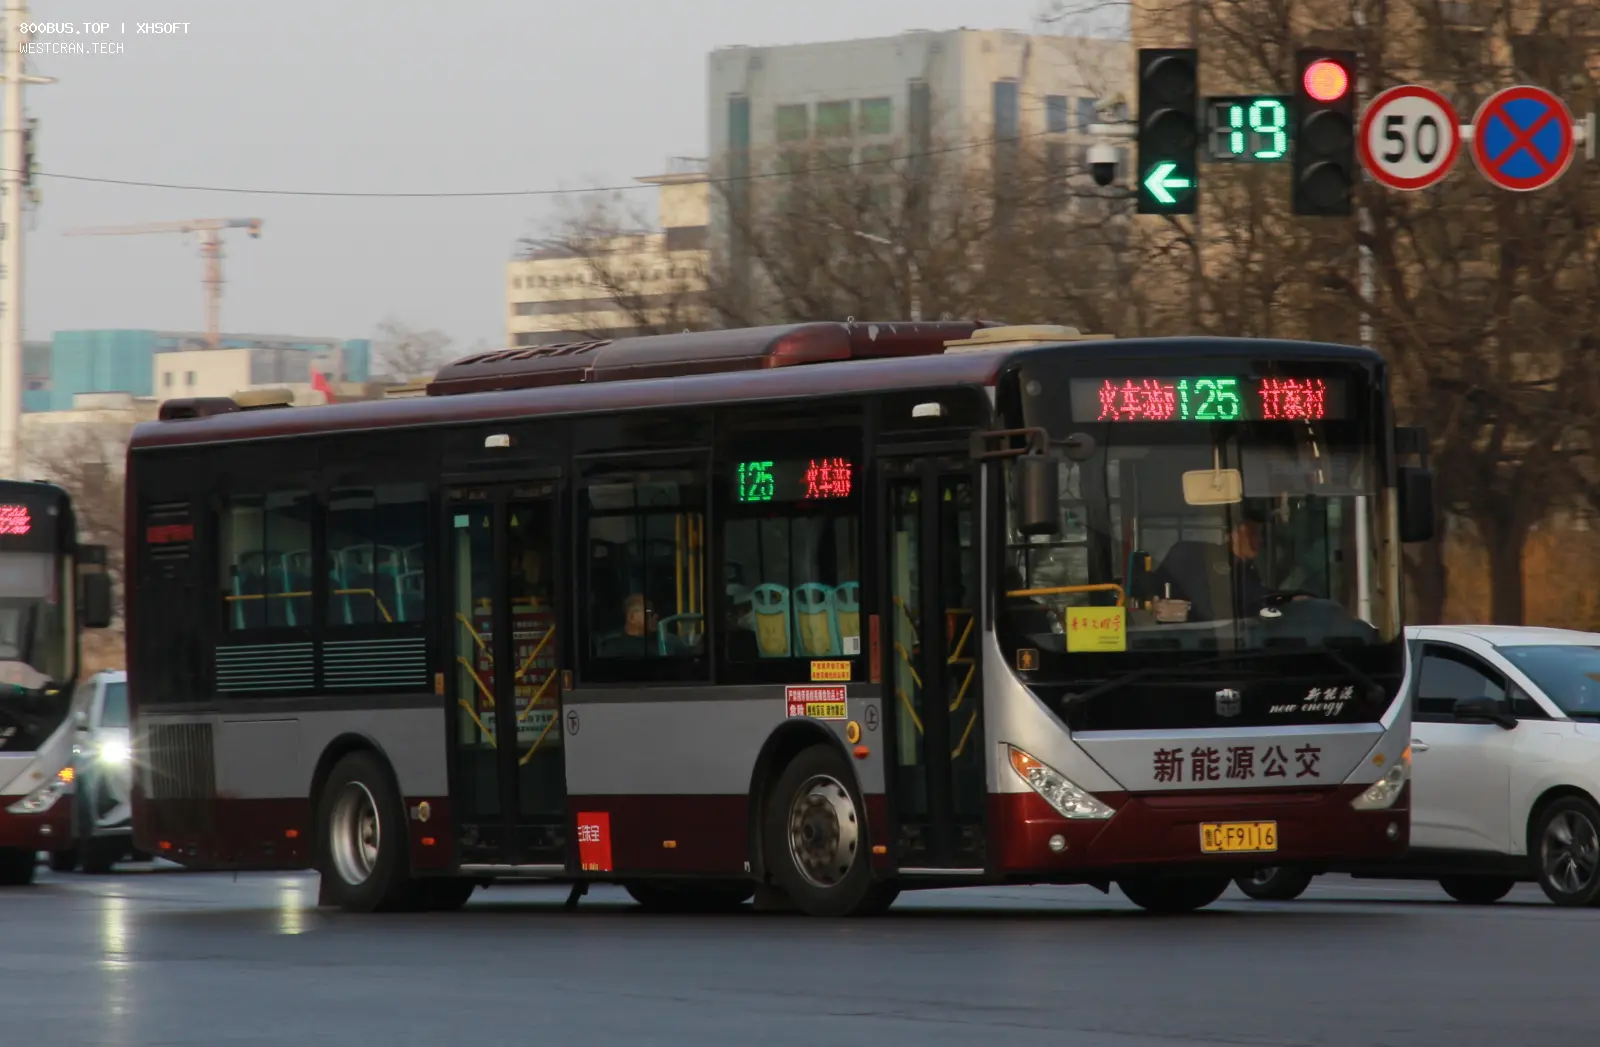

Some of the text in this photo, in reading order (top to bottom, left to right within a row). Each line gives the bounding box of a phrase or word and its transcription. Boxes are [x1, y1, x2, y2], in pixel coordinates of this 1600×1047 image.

[1229, 99, 1287, 159] 19
[1381, 114, 1440, 164] 50
[1177, 379, 1239, 420] 125
[738, 461, 774, 501] 125
[789, 704, 805, 717] 危险
[1269, 701, 1344, 716] new energy
[1304, 685, 1354, 701] 新能源
[1153, 743, 1321, 782] 新能源公交
